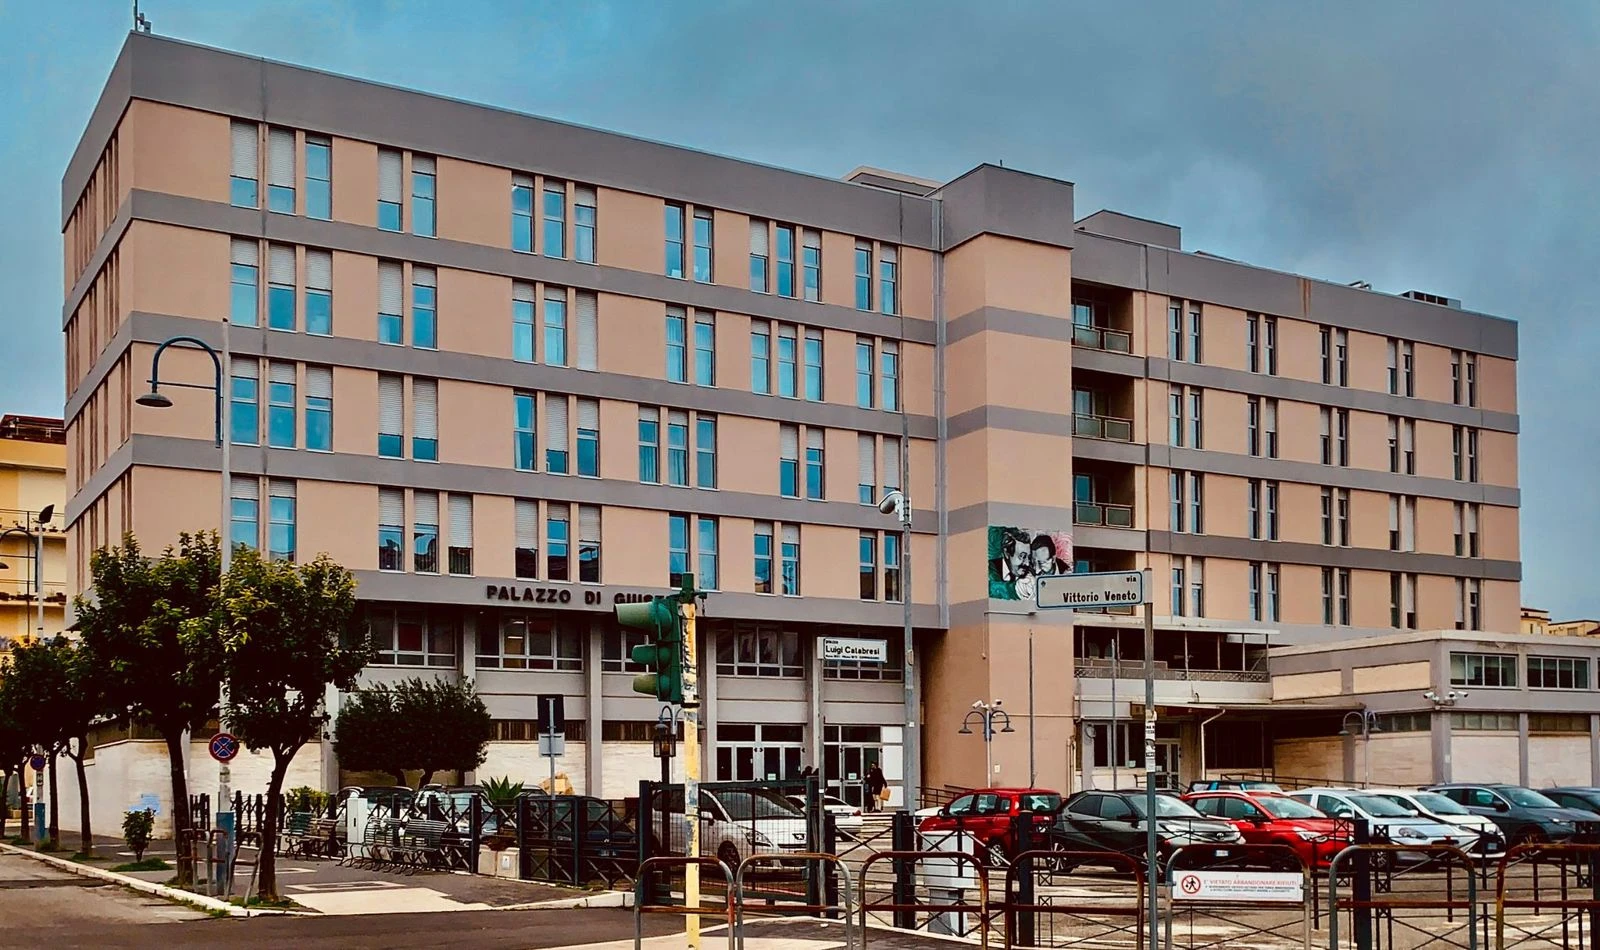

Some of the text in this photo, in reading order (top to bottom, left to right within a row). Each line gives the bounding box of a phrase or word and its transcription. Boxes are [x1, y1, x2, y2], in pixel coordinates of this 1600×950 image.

[486, 585, 665, 605] PALAZZO DI GIUS
[1063, 590, 1137, 603] Vittorio Veneto
[825, 645, 880, 655] Luigi Calabresi
